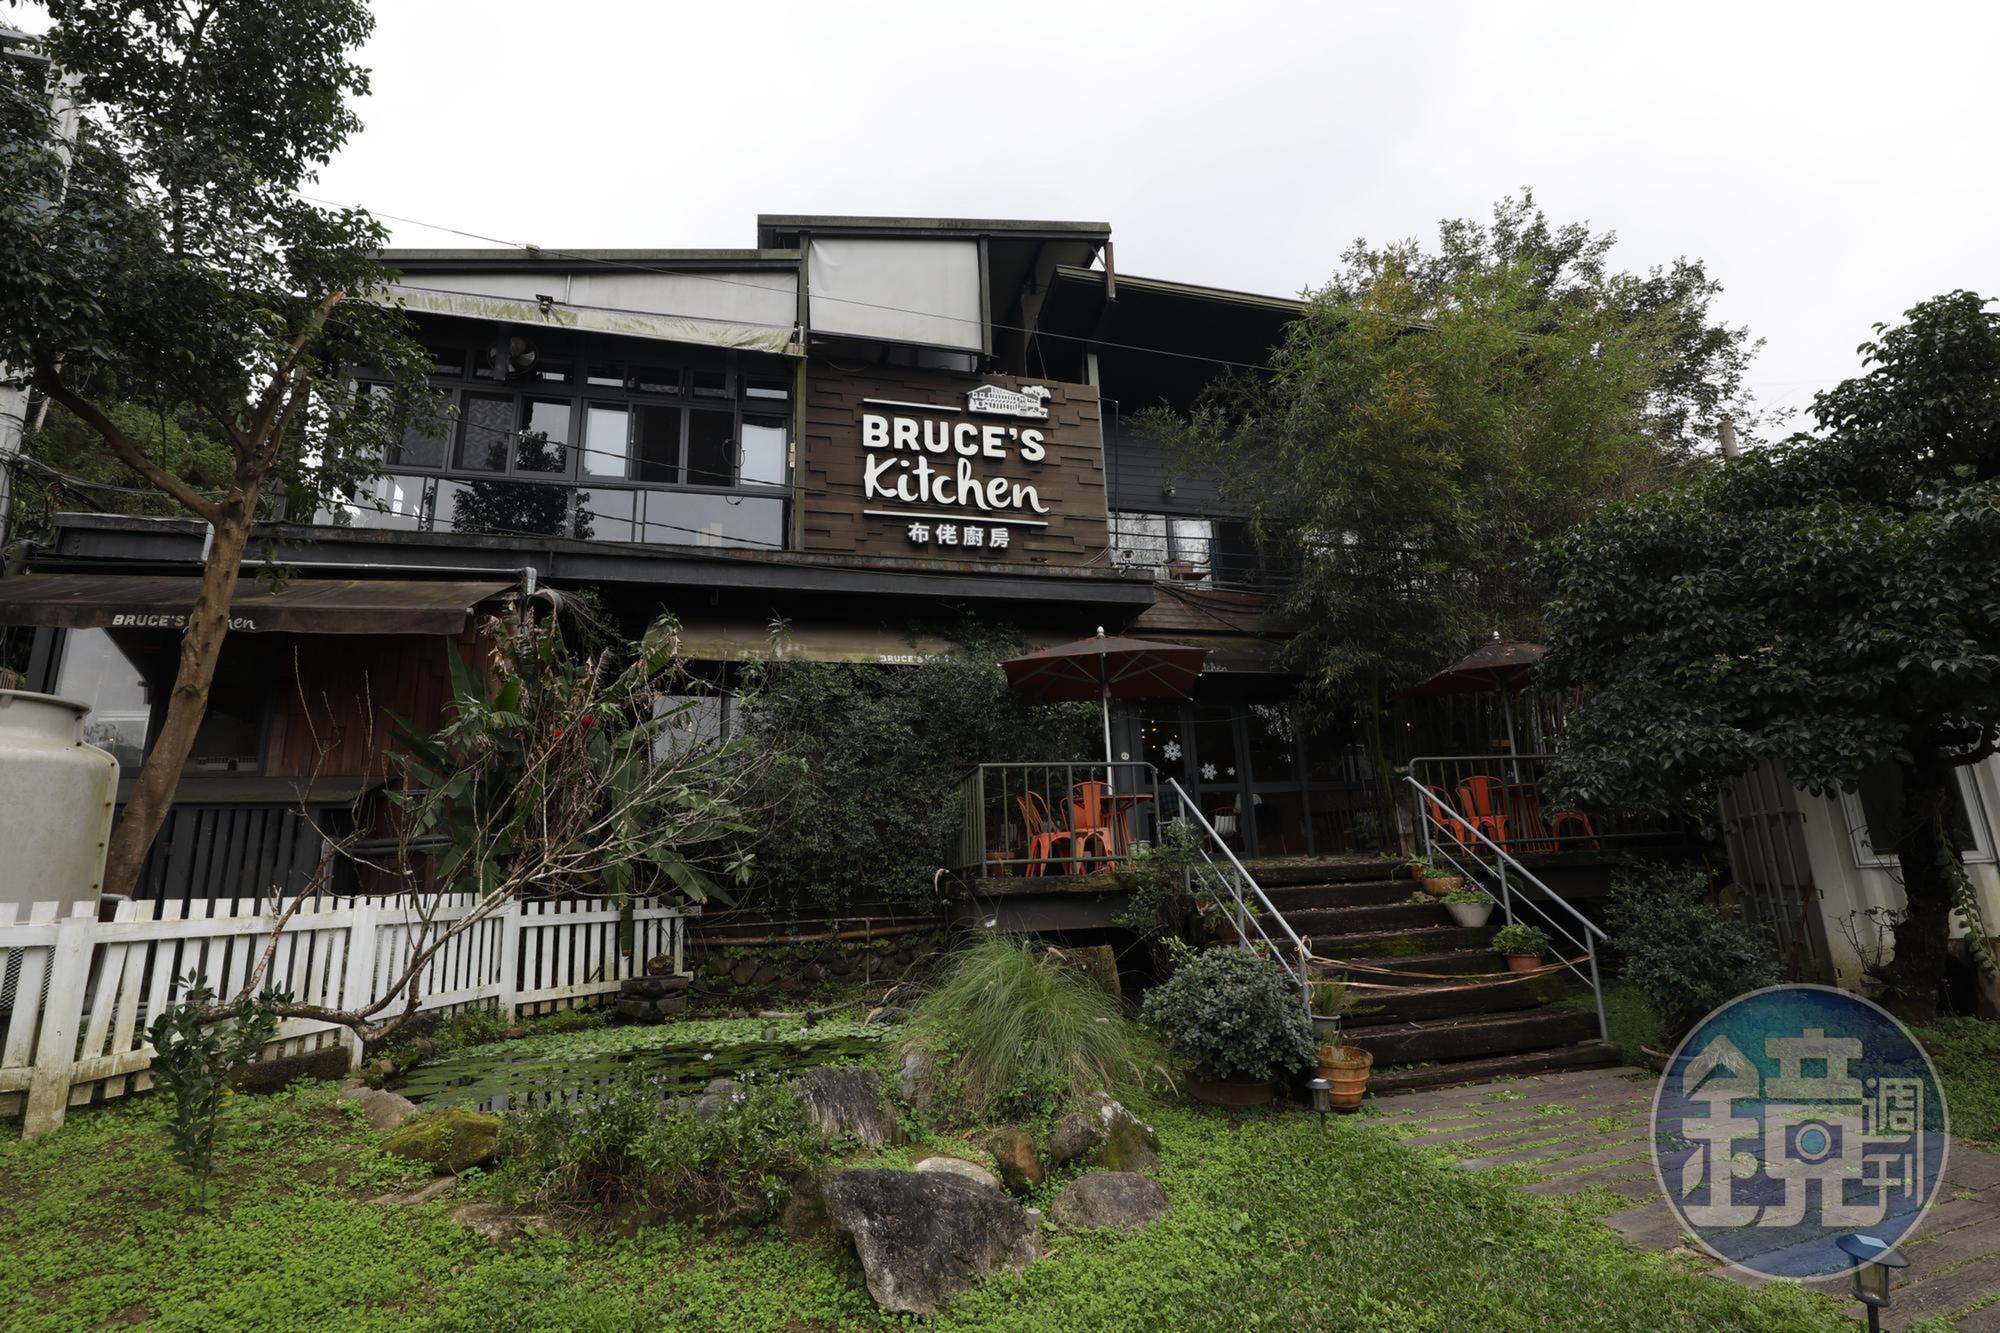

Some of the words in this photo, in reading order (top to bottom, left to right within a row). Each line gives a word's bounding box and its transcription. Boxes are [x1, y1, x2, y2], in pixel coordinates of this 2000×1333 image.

[862, 414, 1046, 462] BRUCE'S
[864, 453, 1050, 514] Kitchen
[908, 522, 1010, 548] 布佬廚房
[112, 614, 185, 627] BRUCE'S
